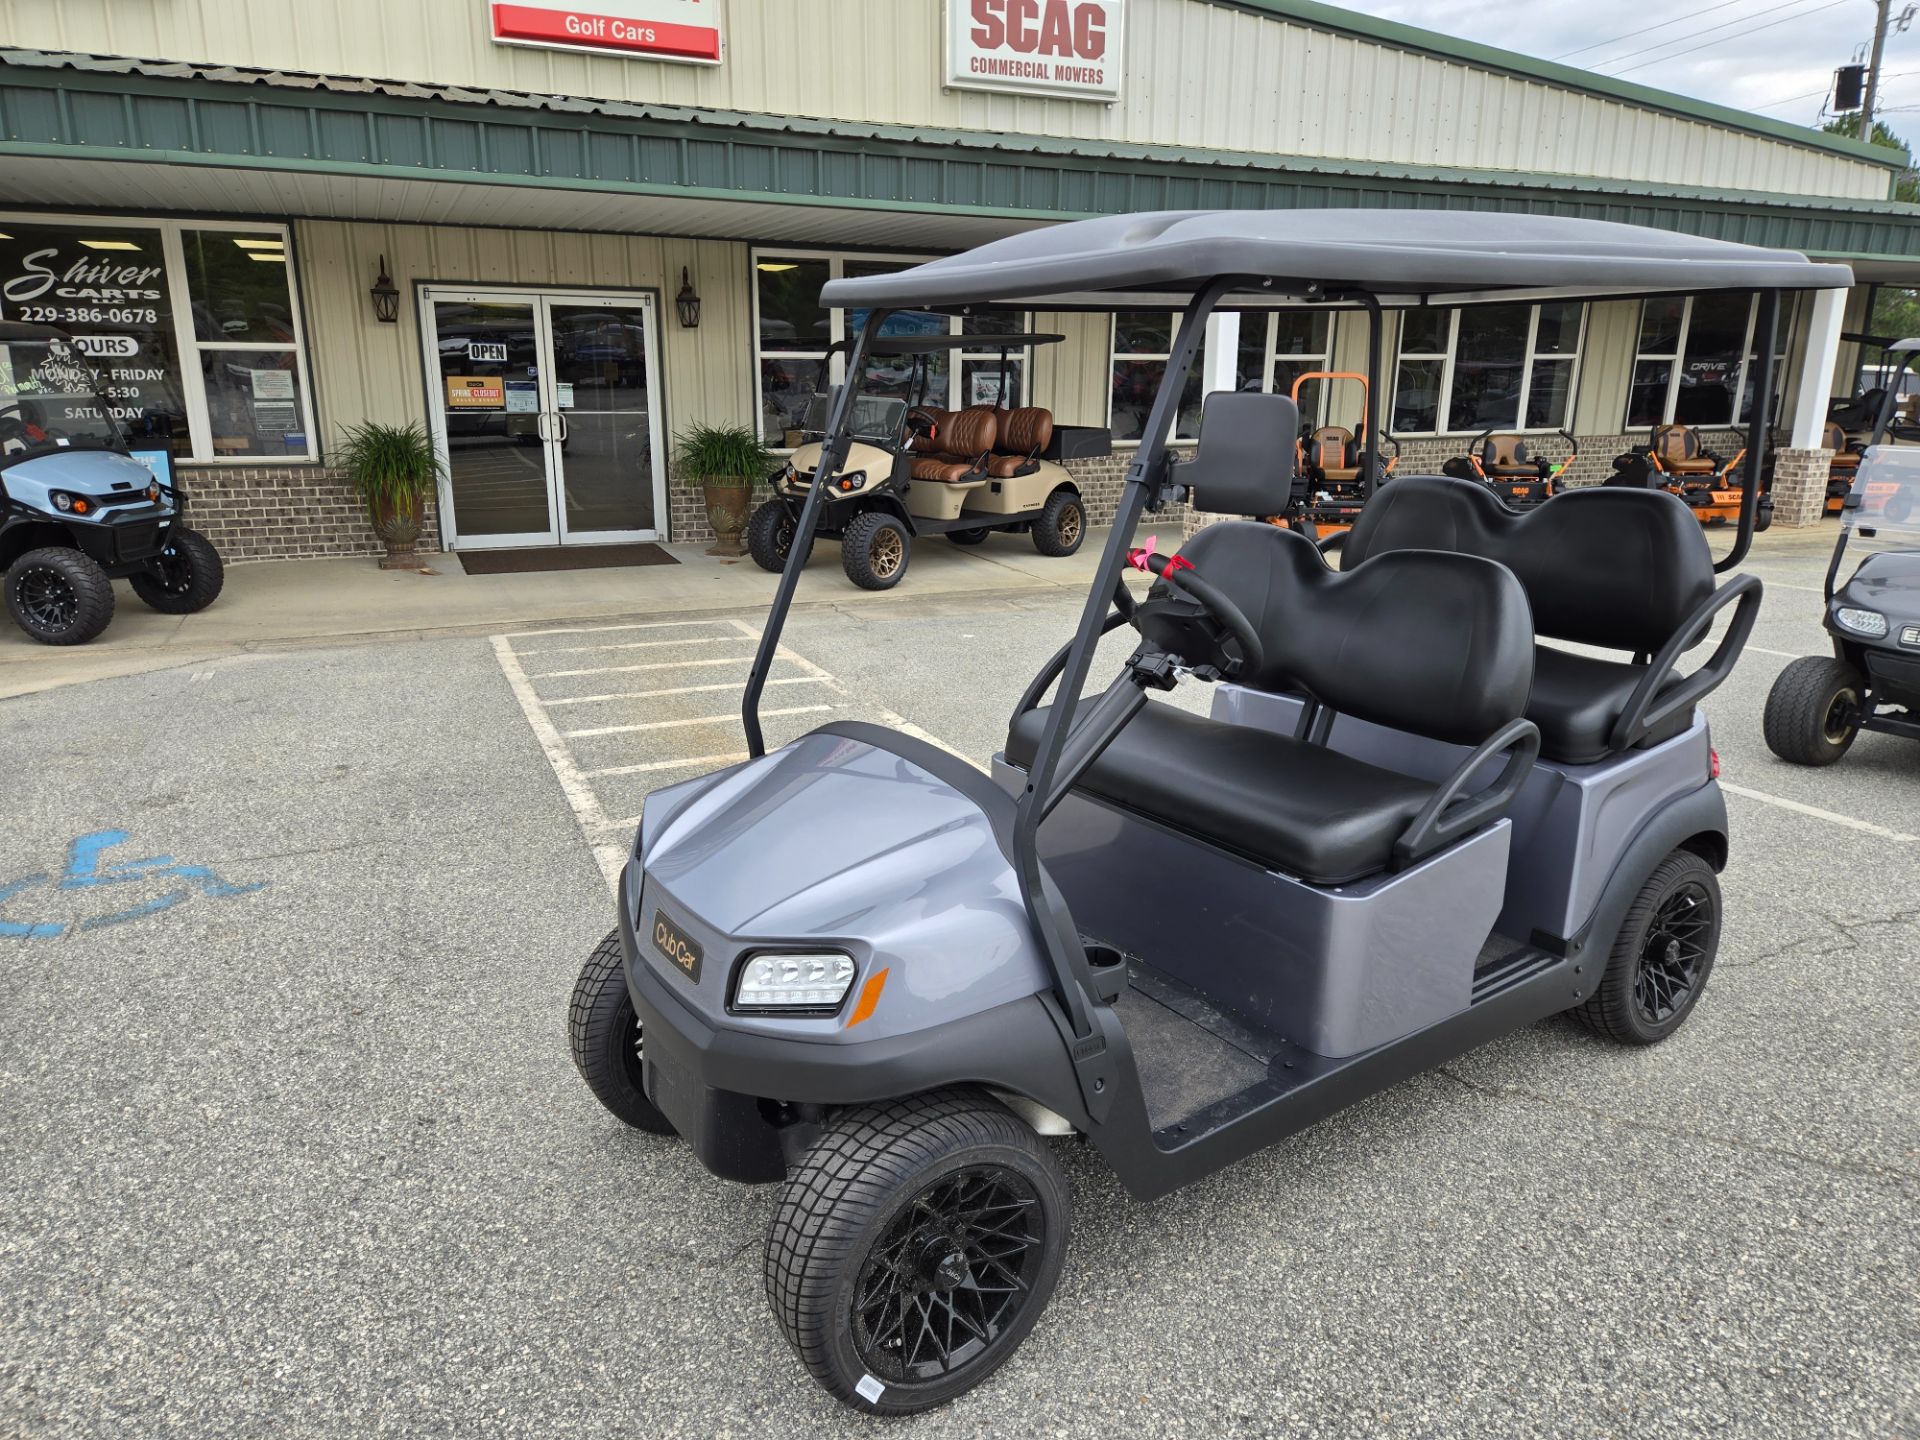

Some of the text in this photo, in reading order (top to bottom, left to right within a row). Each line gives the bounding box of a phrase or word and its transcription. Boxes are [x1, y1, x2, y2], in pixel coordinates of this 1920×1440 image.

[565, 15, 656, 42] Golf Cars
[971, 0, 1106, 60] SCAG
[971, 57, 1104, 85] COMMERCIAL MOWERS
[3, 248, 161, 302] Shiver
[56, 288, 161, 300] CARTS
[20, 306, 158, 323] 229-386-0678
[880, 324, 930, 336] ALOR
[471, 344, 504, 360] OPEN
[1690, 362, 1728, 371] DRIVE
[111, 369, 164, 381] FRIDAY
[108, 387, 139, 398] 5:30
[656, 922, 696, 971] Club Car
